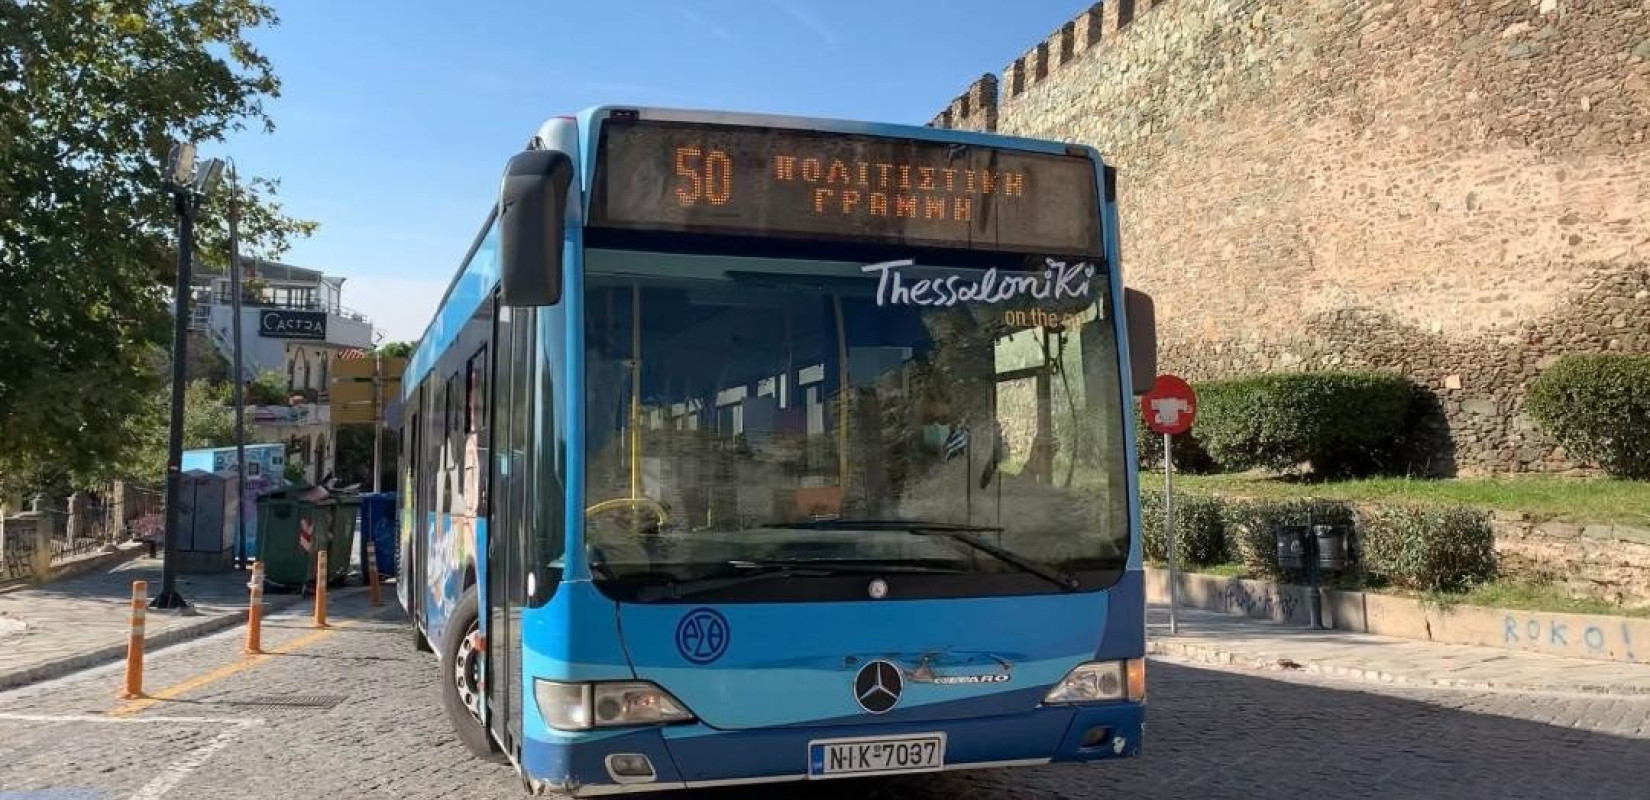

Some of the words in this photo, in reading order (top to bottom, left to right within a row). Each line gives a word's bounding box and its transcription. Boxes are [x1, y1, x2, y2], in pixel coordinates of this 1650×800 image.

[675, 147, 731, 205] 50
[773, 154, 1023, 198] ΠΟΛΙΤΙΣΤΙΚΗ
[815, 187, 972, 221] ΓΡΑΜΜΗ
[1004, 309, 1027, 327] on
[1030, 307, 1059, 329] the
